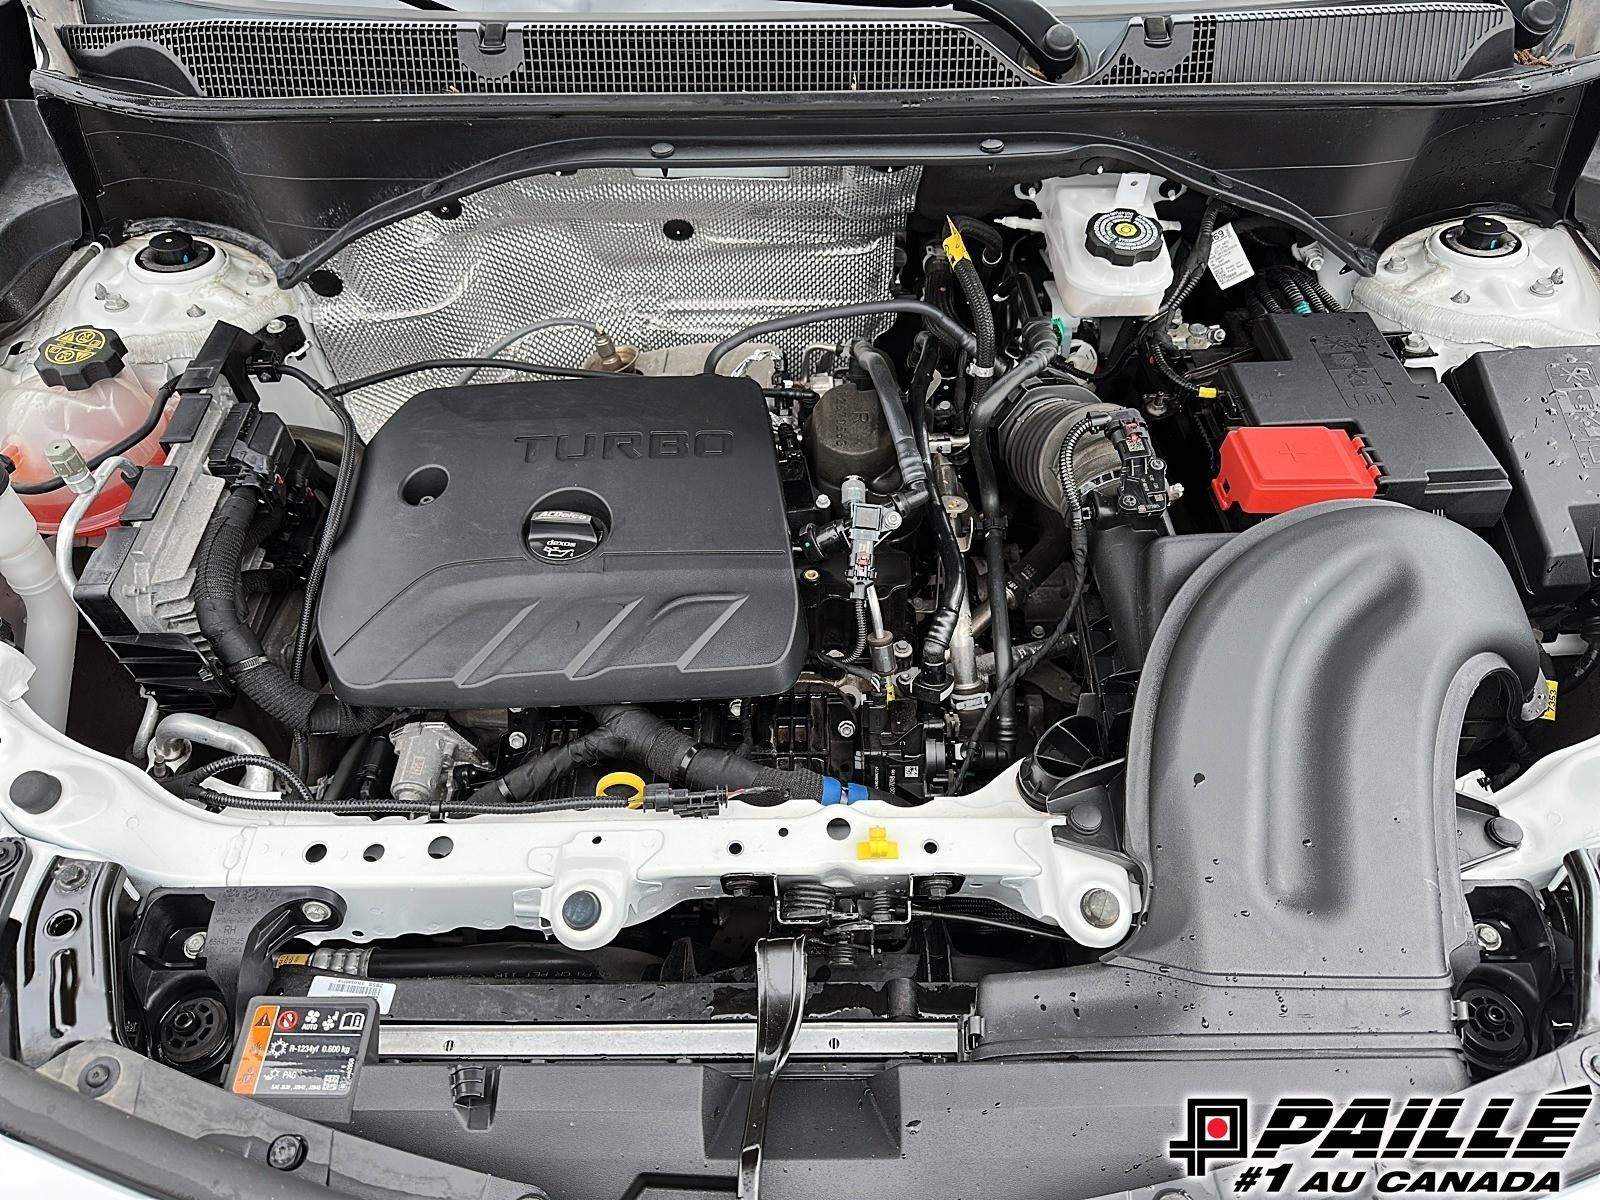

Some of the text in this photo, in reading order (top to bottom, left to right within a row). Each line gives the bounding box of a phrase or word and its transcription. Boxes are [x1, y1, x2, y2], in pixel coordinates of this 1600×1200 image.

[514, 429, 734, 463] TURBO
[536, 511, 588, 520] ACDelco
[546, 539, 577, 548] dexos
[1547, 689, 1557, 713] 7353
[223, 924, 236, 935] RH
[301, 1023, 318, 1031] AUTO
[289, 1044, 351, 1054] R-1234yf 0.600 kg
[282, 1071, 297, 1079] PAG
